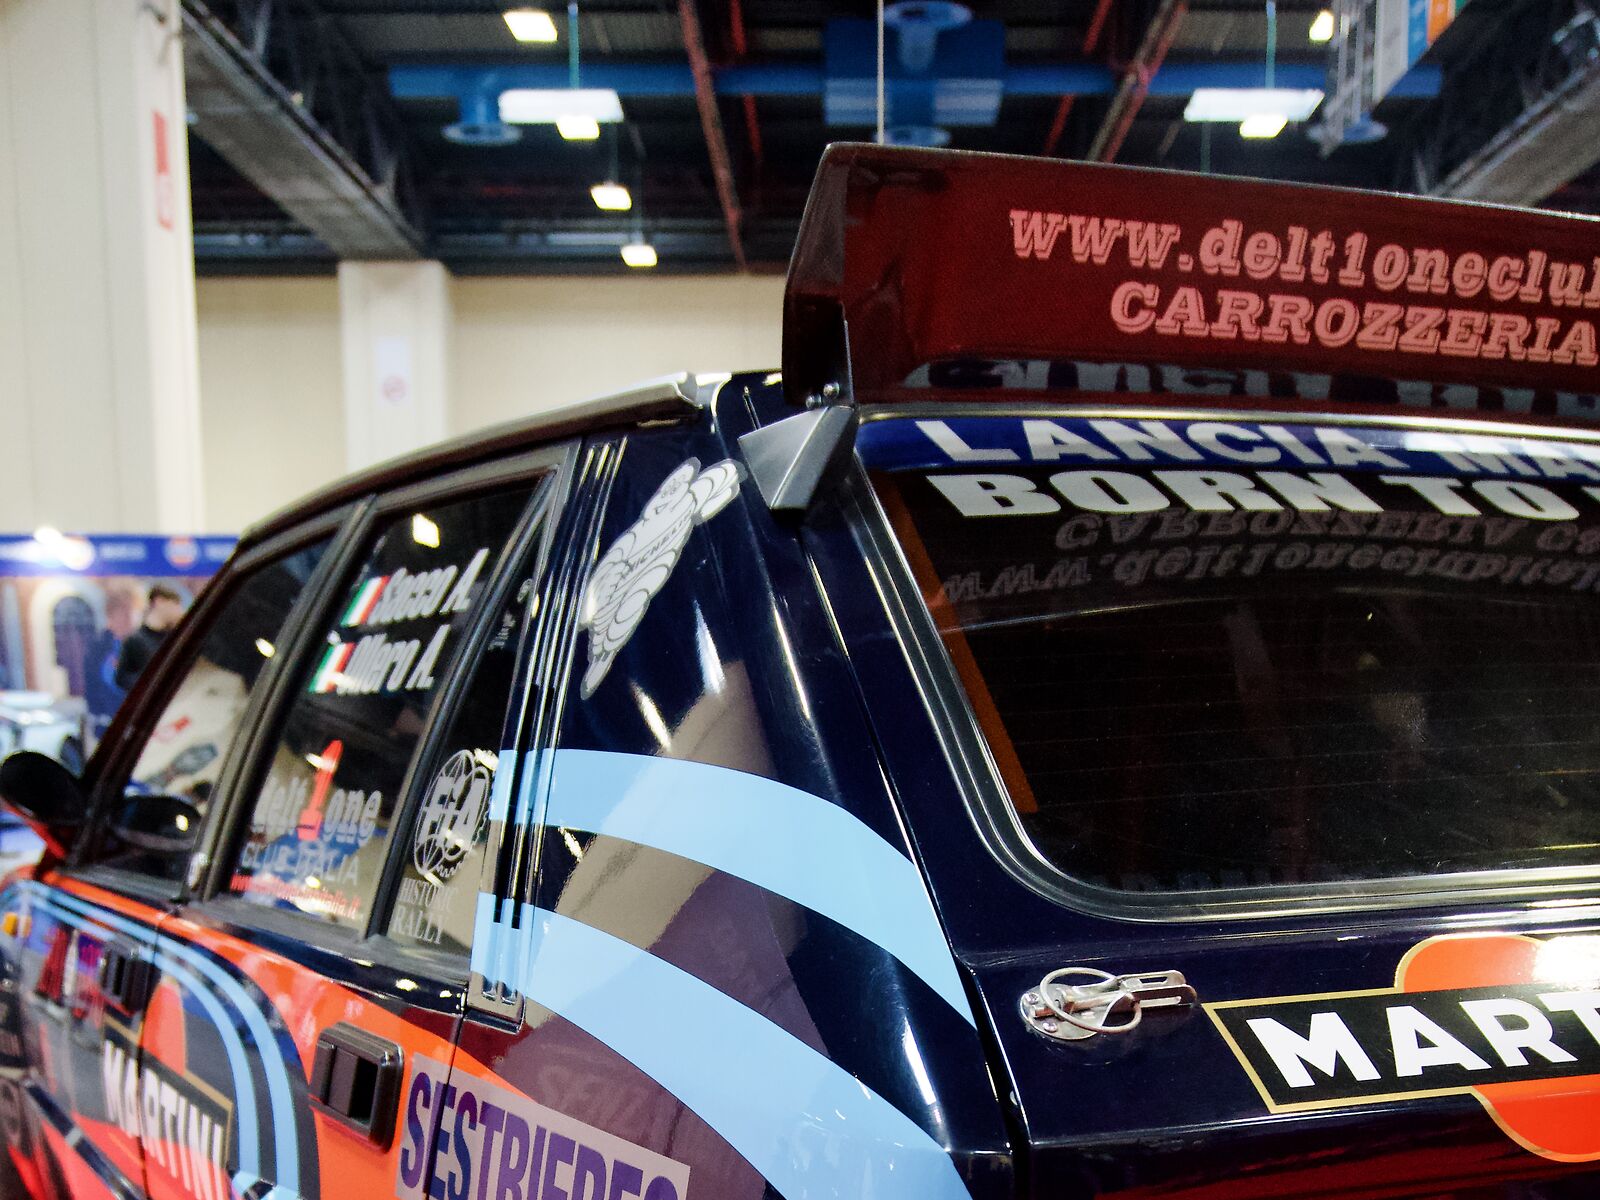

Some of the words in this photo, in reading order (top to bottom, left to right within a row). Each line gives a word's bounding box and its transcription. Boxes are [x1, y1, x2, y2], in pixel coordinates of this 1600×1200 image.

[1110, 282, 1599, 367] CARROZZERIA
[915, 420, 1410, 468] LANCIA
[926, 470, 1385, 517] BORN
[1379, 475, 1580, 521] TO
